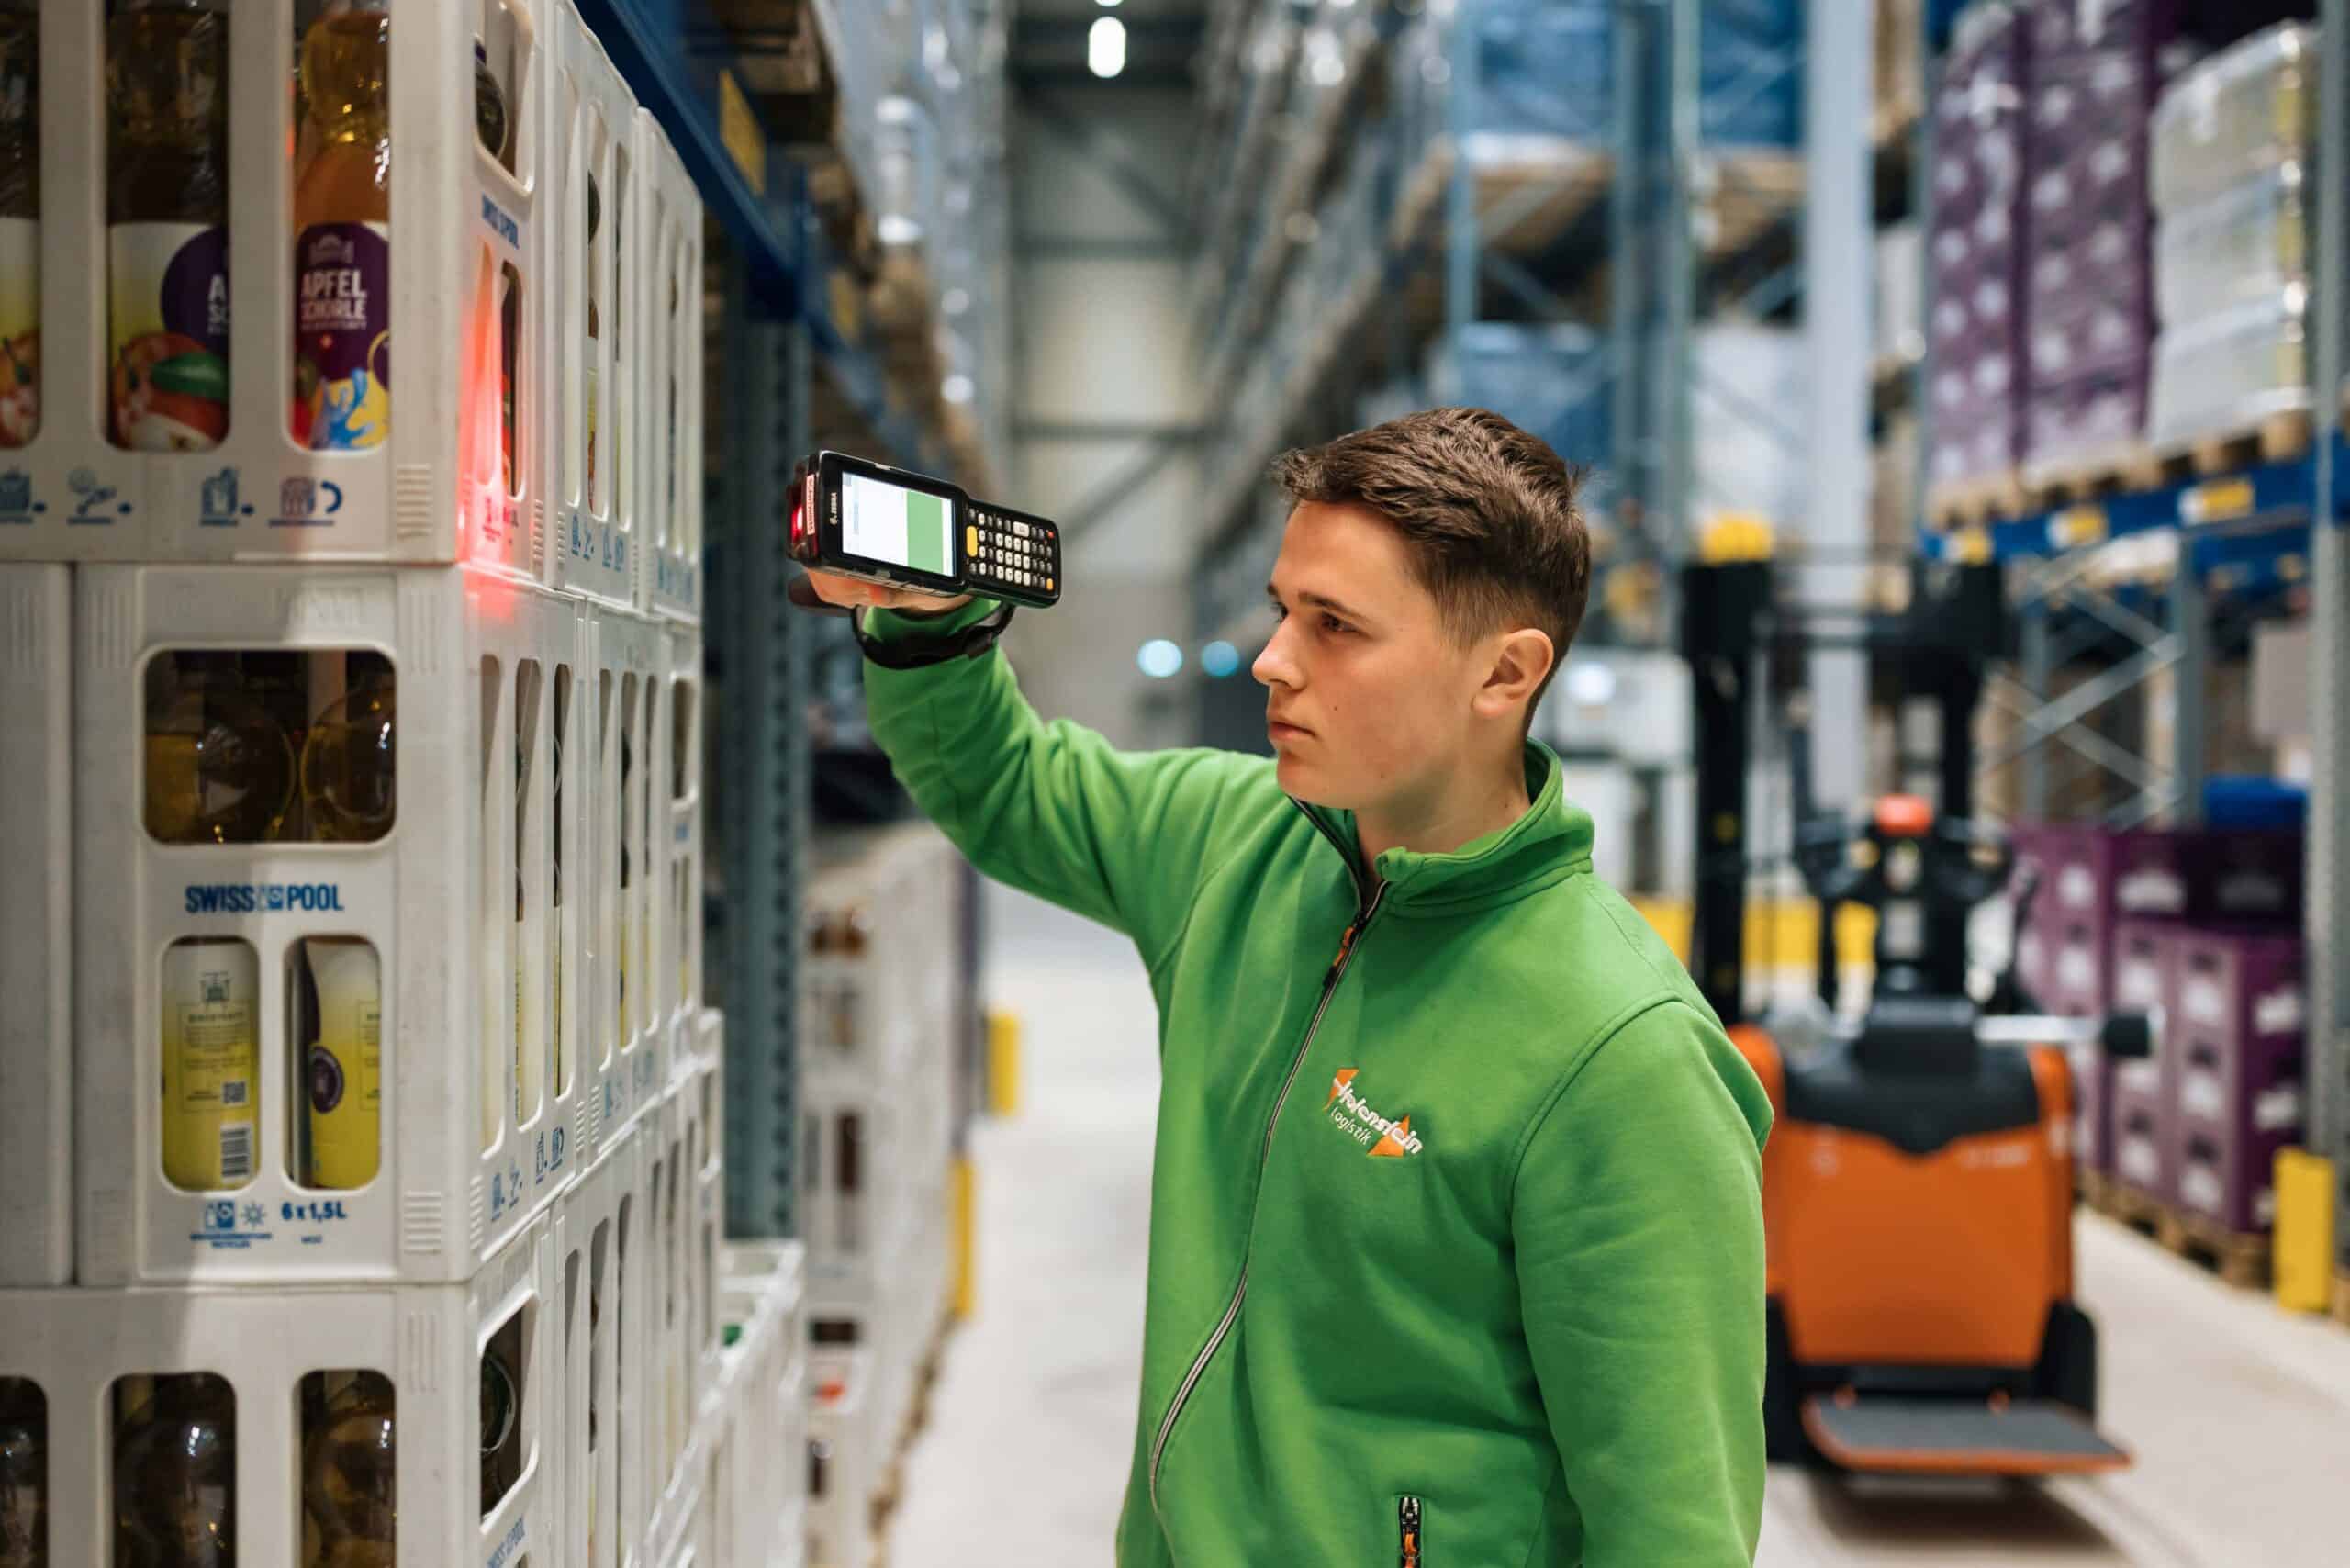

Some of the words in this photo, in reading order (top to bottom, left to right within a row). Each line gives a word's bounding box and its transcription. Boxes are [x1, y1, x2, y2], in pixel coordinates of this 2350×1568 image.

[301, 269, 368, 297] APFEL
[185, 884, 254, 913] SWISS
[287, 883, 344, 912] POOL
[281, 1202, 293, 1220] 6
